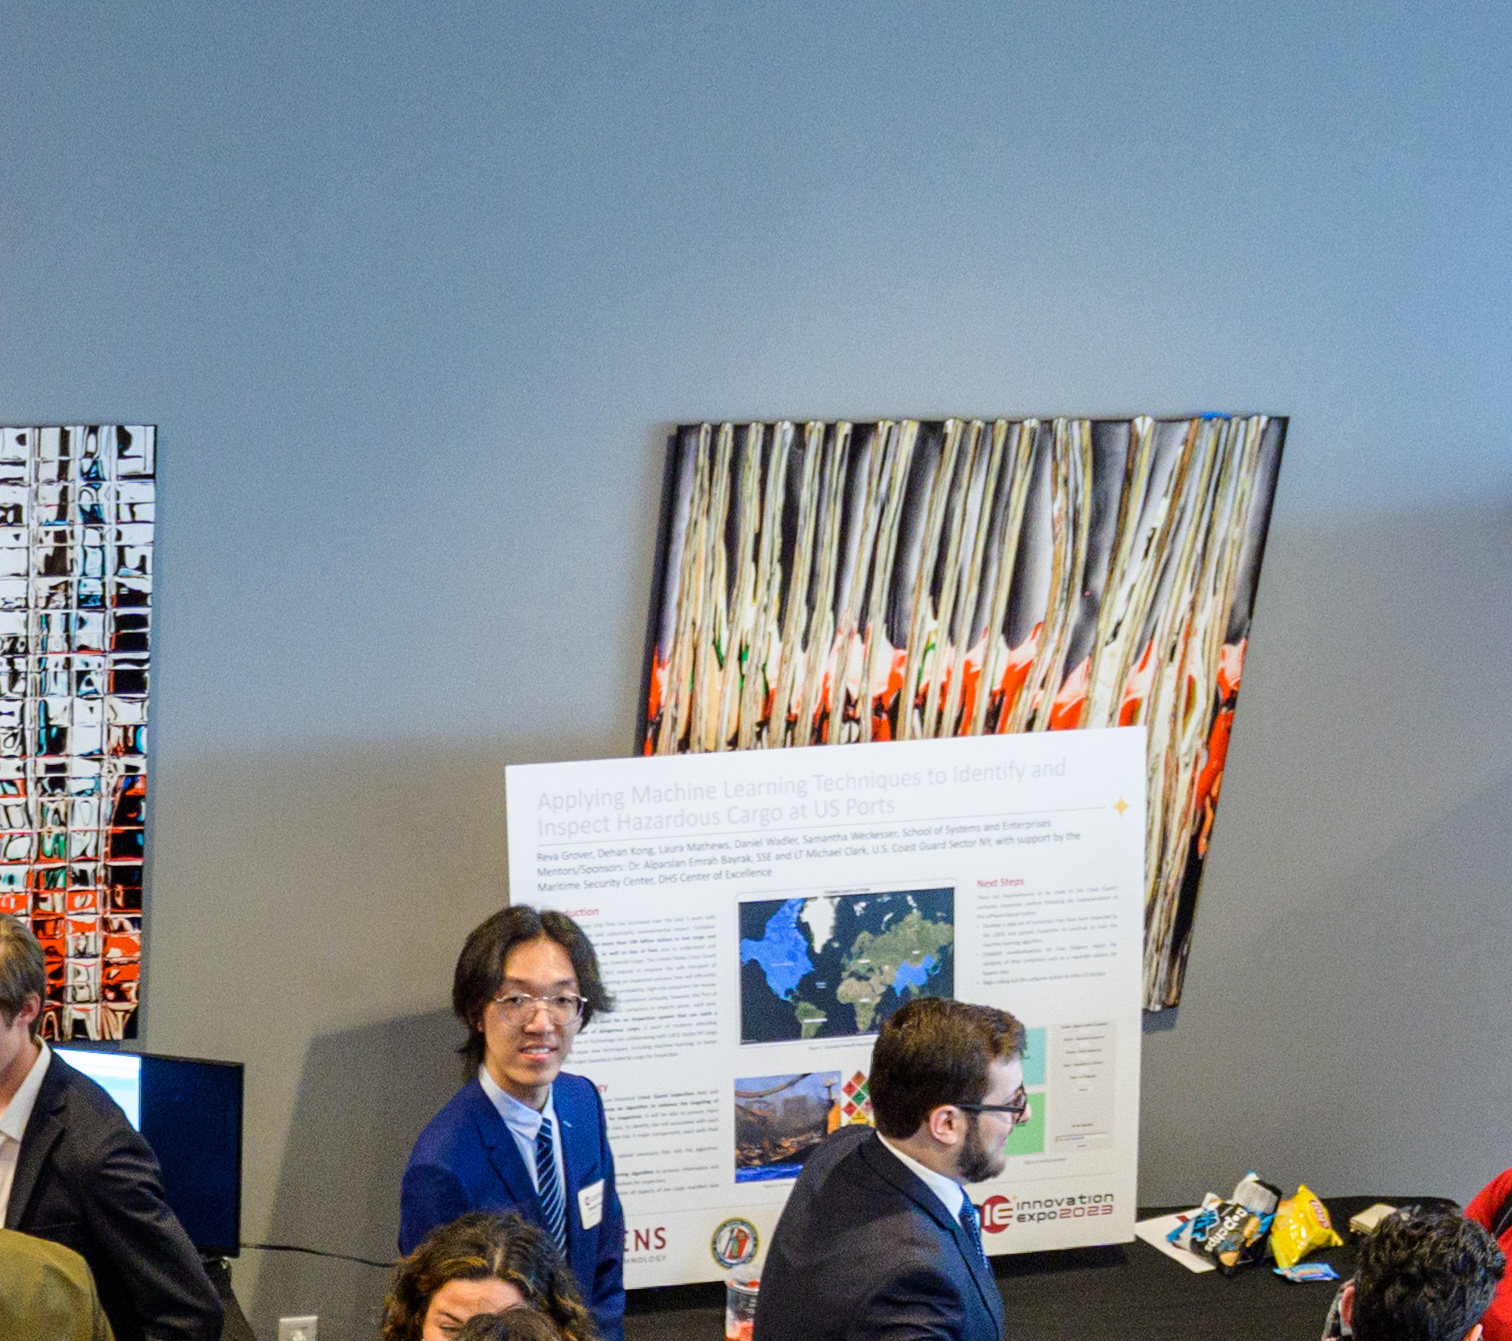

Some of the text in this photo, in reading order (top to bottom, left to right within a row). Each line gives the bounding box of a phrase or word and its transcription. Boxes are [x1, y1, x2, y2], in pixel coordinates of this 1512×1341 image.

[538, 758, 1065, 813] Applying Machine Learning Techniques to Identify and
[539, 798, 894, 837] Inspect Hazardous Cargo at US Ports
[977, 878, 1023, 887] Next Steps
[1017, 1191, 1113, 1210] innovation
[982, 1198, 1013, 1230] IE
[1017, 1204, 1113, 1225] expo2023
